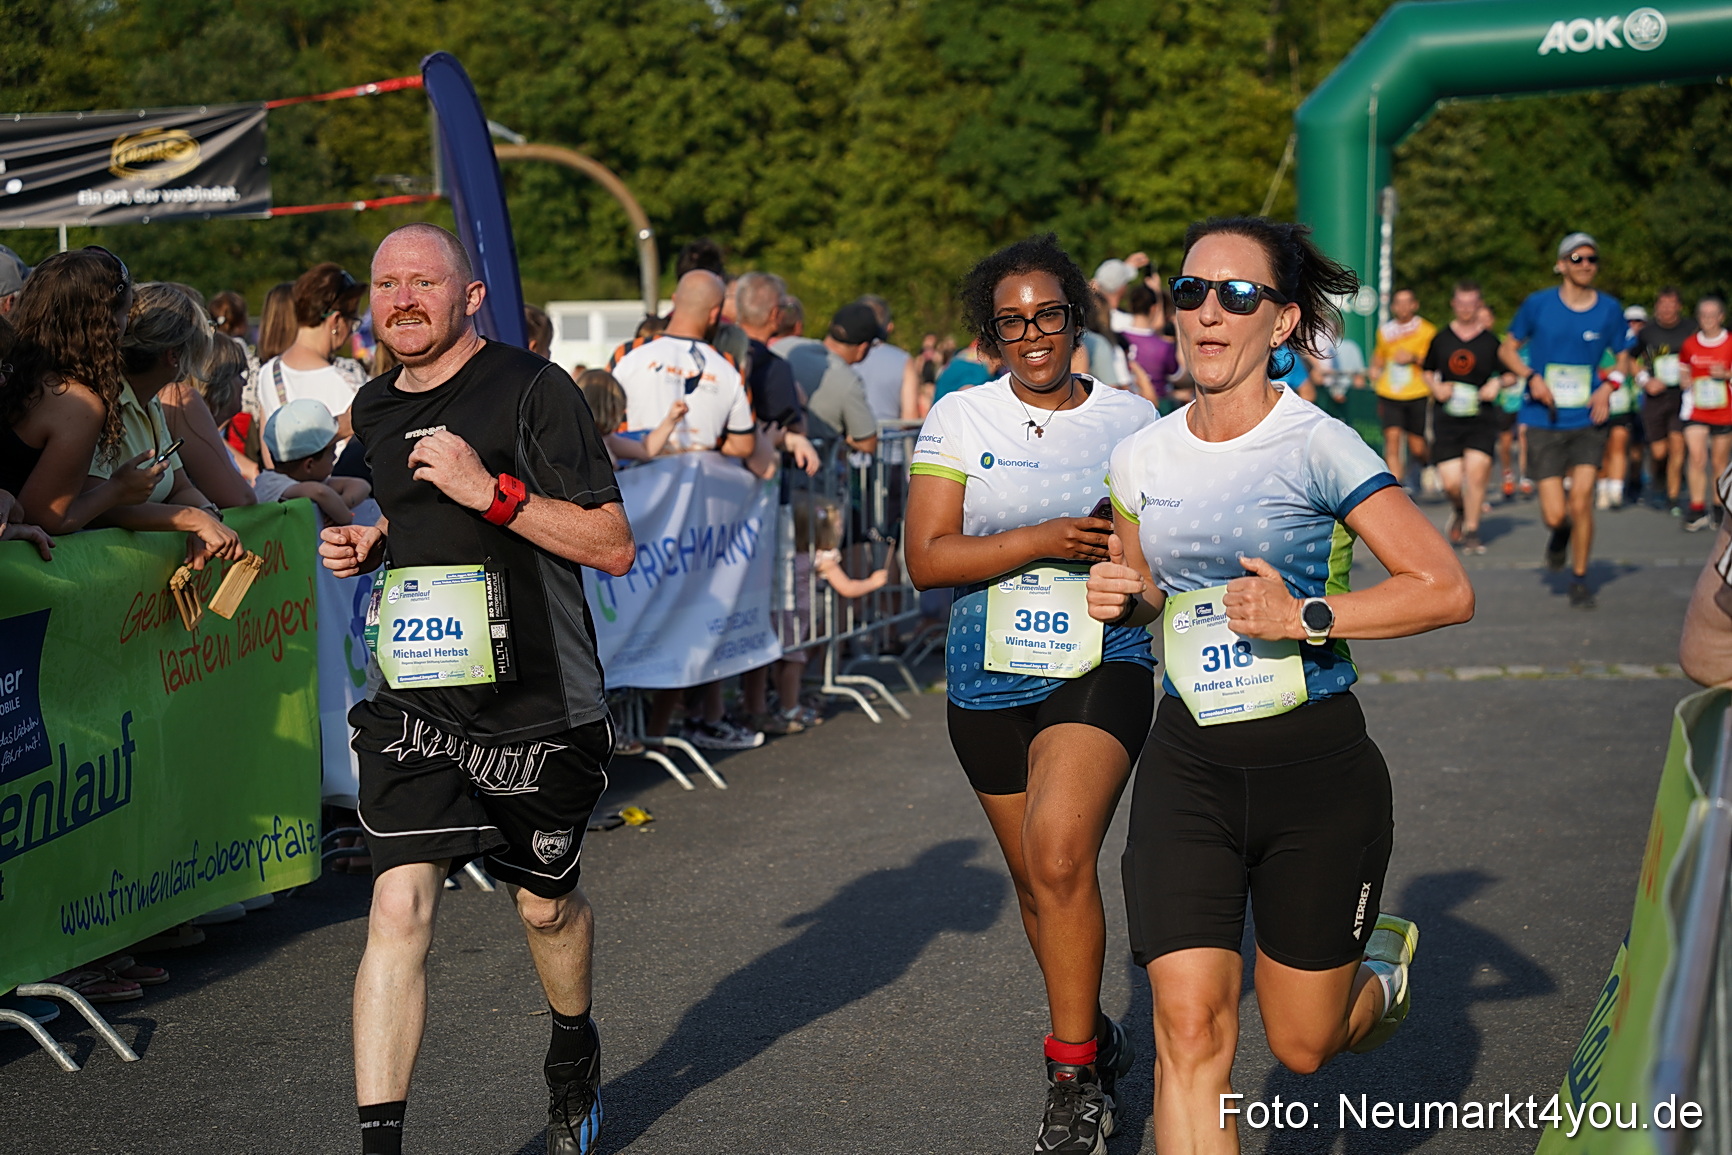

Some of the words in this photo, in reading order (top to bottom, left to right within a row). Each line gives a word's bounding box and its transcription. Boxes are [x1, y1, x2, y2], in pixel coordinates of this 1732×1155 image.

[1537, 15, 1623, 56] AOK
[78, 189, 100, 206] Ein
[400, 590, 431, 599] Firmenlauf
[486, 572, 494, 601] RABATT
[392, 617, 464, 642] 2284
[1014, 609, 1069, 634] 386
[392, 648, 432, 659] Michael
[434, 647, 469, 658] Herbst
[1005, 636, 1047, 649] Wintana
[496, 641, 507, 674] HILTL
[1202, 640, 1254, 673] 318
[1193, 680, 1232, 693] Andrea
[1354, 882, 1371, 927] TERREX
